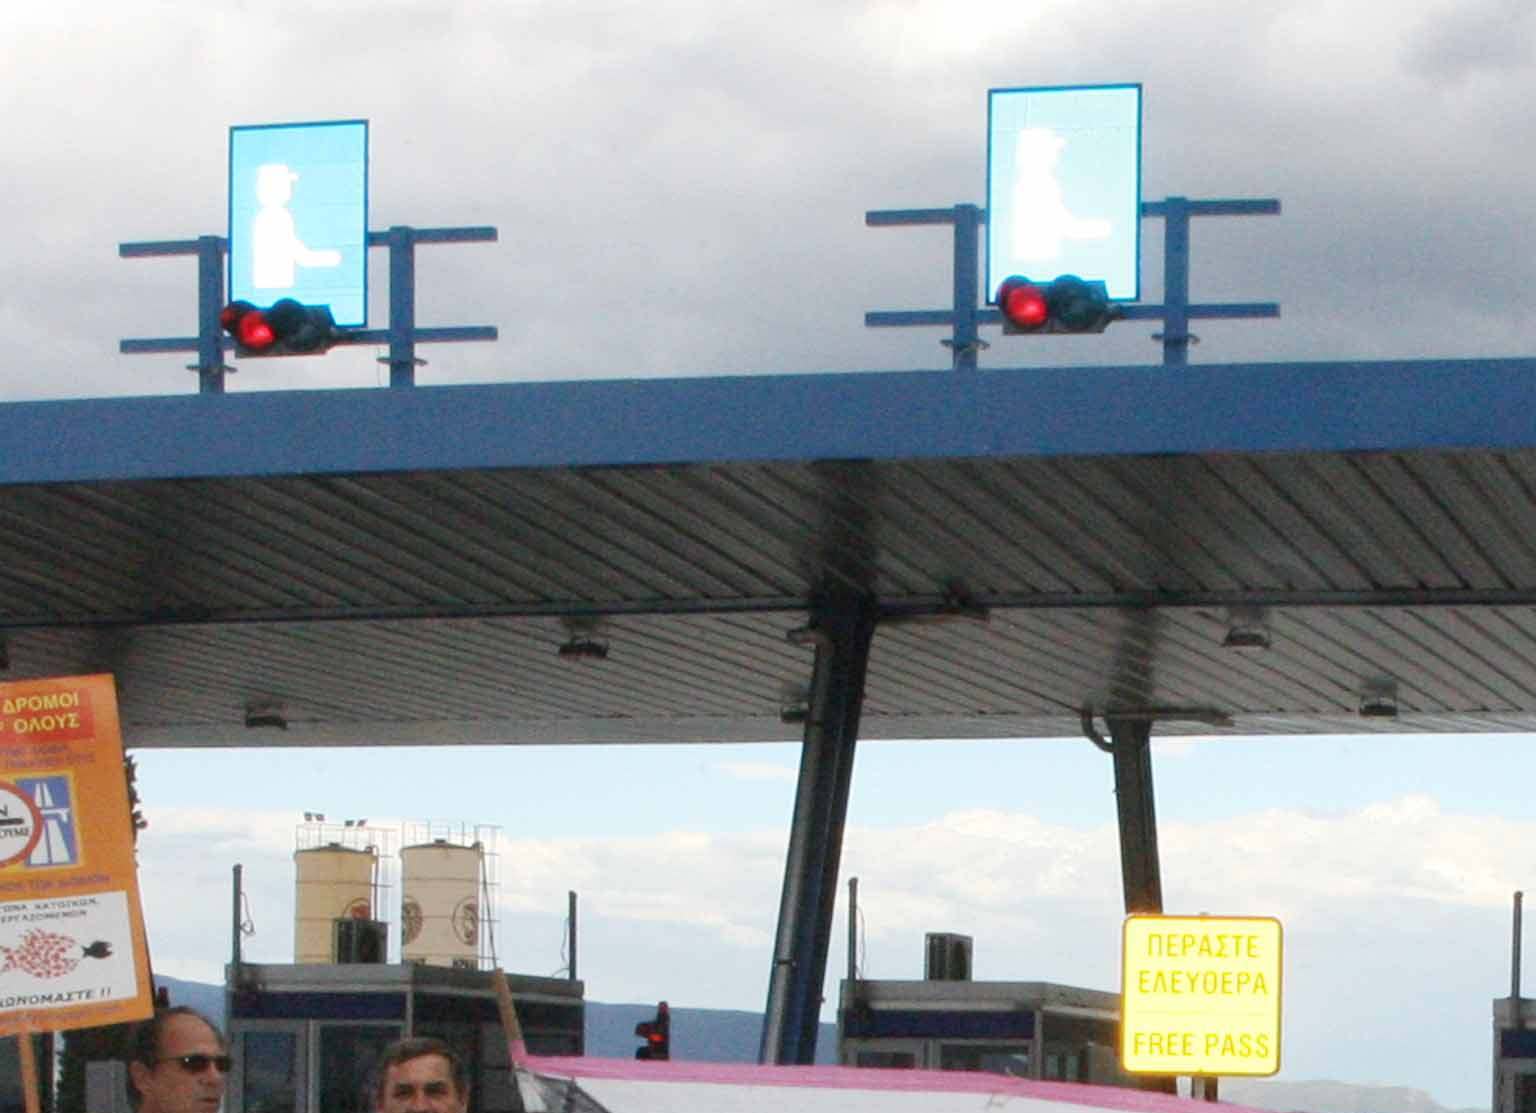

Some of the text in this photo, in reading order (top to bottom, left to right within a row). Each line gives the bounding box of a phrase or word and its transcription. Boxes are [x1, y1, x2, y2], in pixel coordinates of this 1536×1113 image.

[1147, 933, 1261, 959] ΠΕΡΑΣΤΕ
[1133, 1032, 1271, 1059] FREE PASS
